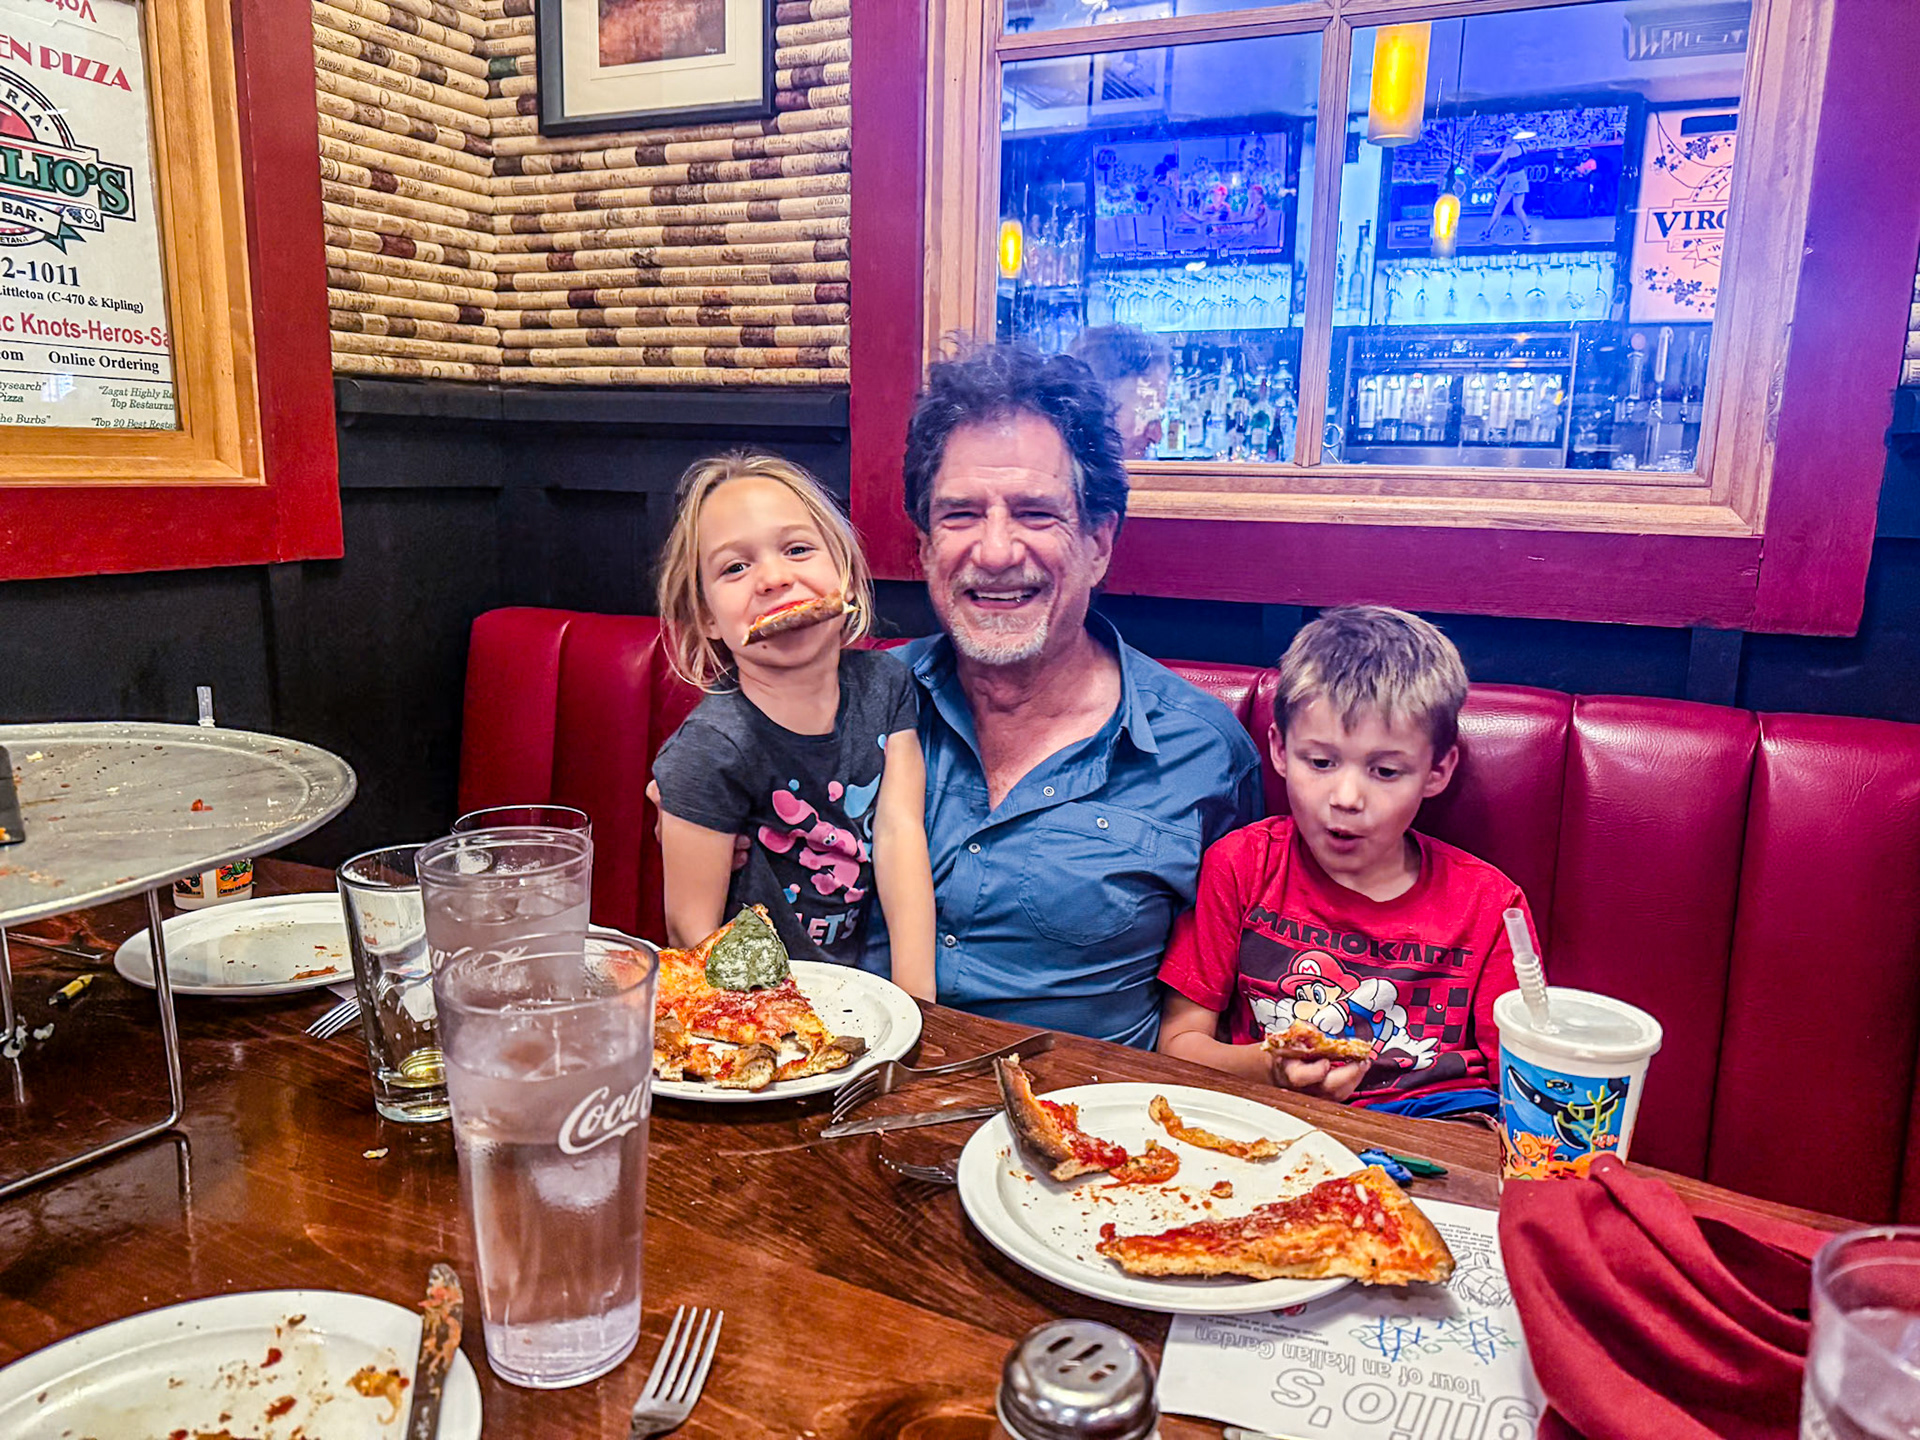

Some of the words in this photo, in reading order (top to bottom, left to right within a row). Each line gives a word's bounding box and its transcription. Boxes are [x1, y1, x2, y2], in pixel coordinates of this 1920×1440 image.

[40, 45, 132, 92] PIZZA
[2, 201, 38, 223] BAR
[0, 285, 44, 301] ittleton
[47, 291, 85, 305] (C-470
[88, 297, 98, 307] &
[101, 297, 144, 314] Kipling)
[0, 350, 24, 361] om
[49, 350, 96, 367] Online
[99, 354, 160, 375] Ordering
[111, 398, 127, 409] Top
[130, 387, 161, 400] Highly
[1195, 1324, 1275, 1359] Garden
[1282, 1342, 1355, 1376] Italian
[1362, 1358, 1392, 1378] an
[1398, 1365, 1423, 1387] of
[1429, 1372, 1485, 1402] Tour
